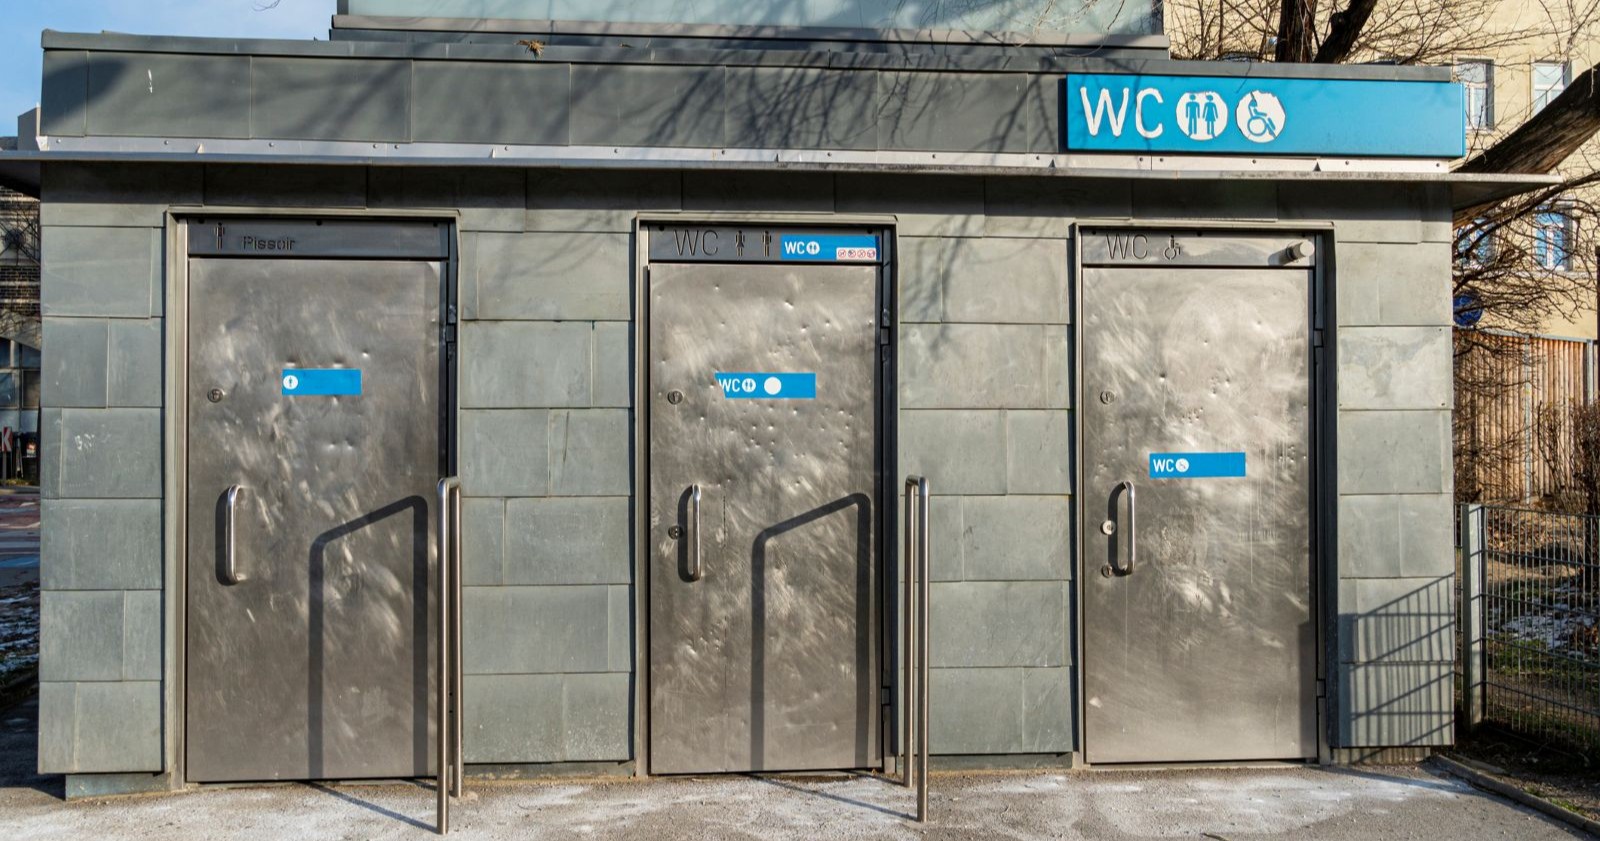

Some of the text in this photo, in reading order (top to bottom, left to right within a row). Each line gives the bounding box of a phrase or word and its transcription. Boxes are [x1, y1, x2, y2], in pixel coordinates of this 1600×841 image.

[1079, 86, 1164, 139] WC
[242, 236, 296, 251] Pissoir
[673, 229, 719, 256] WC
[784, 241, 805, 255] WC
[1106, 234, 1148, 260] WC
[718, 378, 741, 393] WC
[1153, 458, 1174, 473] WC
